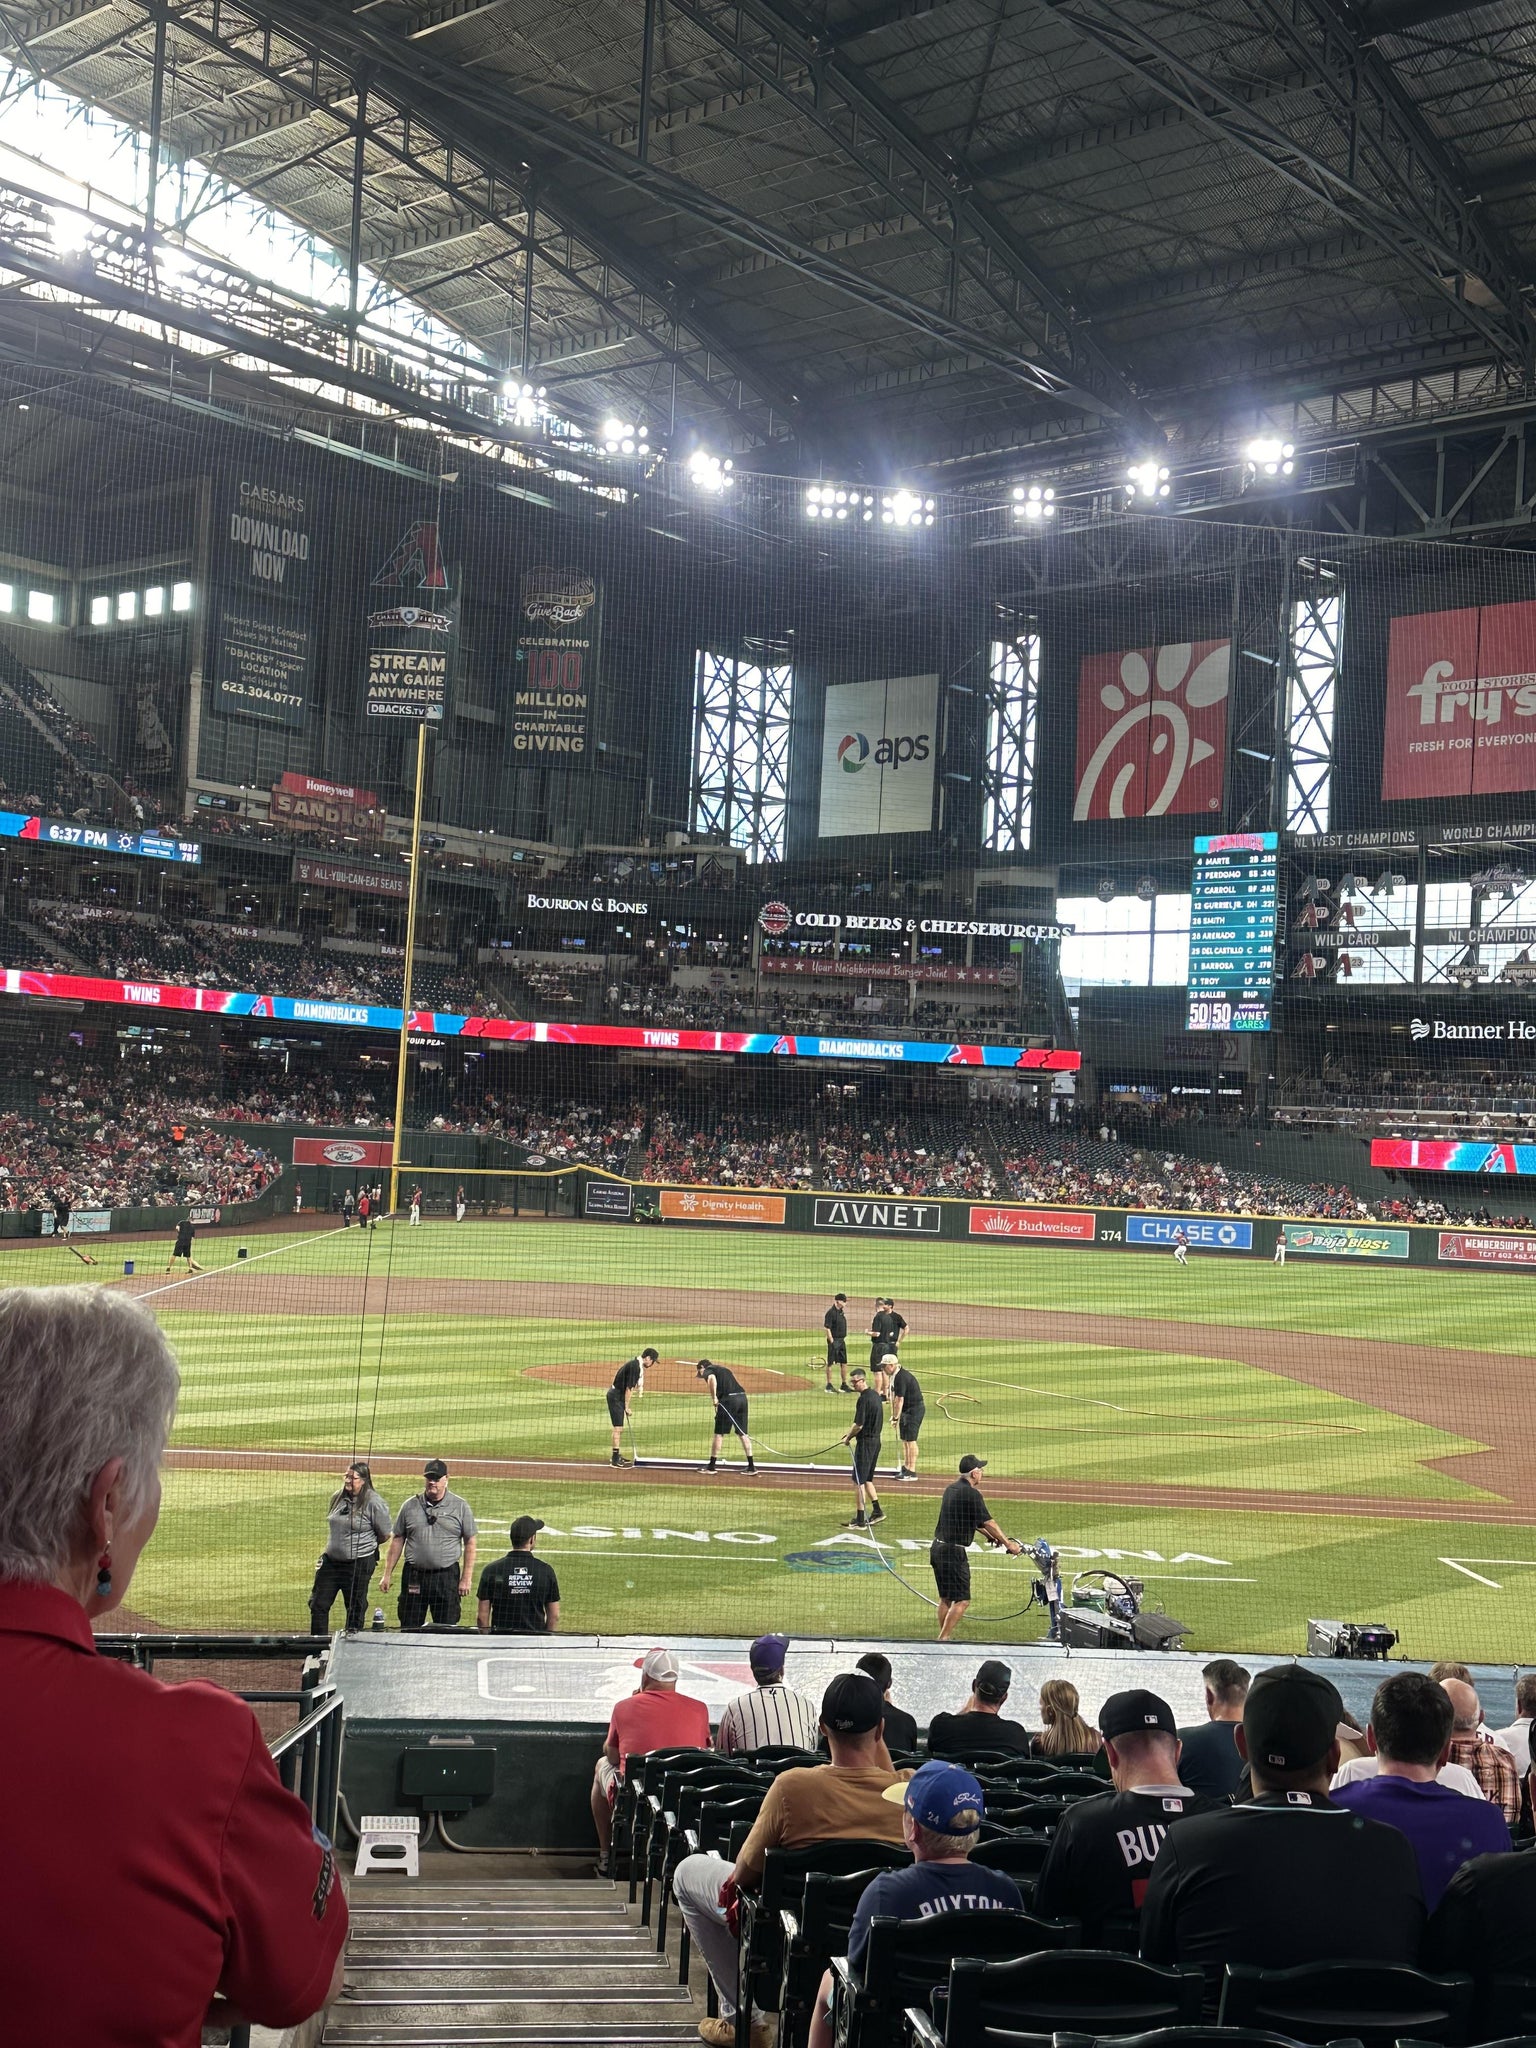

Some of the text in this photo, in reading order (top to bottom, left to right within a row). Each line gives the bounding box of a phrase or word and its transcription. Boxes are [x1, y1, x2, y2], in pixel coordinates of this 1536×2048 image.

[240, 481, 304, 512] CAESARS
[230, 513, 309, 560] DOWNLOAD
[252, 549, 286, 583] NOW
[527, 602, 584, 623] Give Back
[519, 637, 590, 648] CELEBRATING
[240, 661, 288, 680] LOCATION
[369, 654, 446, 672] STREAM
[368, 672, 445, 687] ANY GAME
[221, 680, 303, 707] 623.304.0777
[368, 687, 444, 701] ANYWHERE
[515, 691, 588, 708] MILLION
[543, 710, 557, 720] IN
[514, 722, 585, 734] CHARITABLE
[513, 734, 585, 752] GIVING
[1409, 740, 1445, 753] FRESH
[1448, 738, 1474, 750] FOR
[874, 734, 930, 770] aps
[306, 780, 355, 799] Honeywell
[50, 825, 108, 848] 6:37 PM
[1294, 830, 1415, 848] NL WEST CHAMPIONS
[1442, 826, 1483, 840] WORLD
[1205, 856, 1230, 865] MARTE
[314, 868, 379, 888] ALL-YOU-CAN-EAT
[380, 880, 403, 891] SEATS
[1205, 870, 1241, 879] PERDOMO
[1204, 886, 1236, 894] CARROLL
[591, 898, 604, 912] &
[795, 913, 1073, 940] COLD BEERS & CHEESEBURGERS
[1203, 916, 1225, 924] SMITH
[1202, 931, 1236, 940] ARENADO
[1315, 932, 1379, 947] WILD CARD
[1448, 929, 1464, 943] NL
[1214, 945, 1243, 954] CASTILLO
[811, 961, 948, 979] Your Neighborhood Burger Joint
[1201, 962, 1234, 970] BARBOSA
[1201, 977, 1220, 985] TROY
[123, 985, 368, 1023] TWINS DIAMONDBACKS
[1235, 1020, 1264, 1029] CARES
[1433, 1020, 1504, 1039] Banner
[643, 1031, 904, 1058] TWINS DIAMONDBACKS
[335, 1151, 354, 1161] Ford
[702, 1199, 763, 1211] Dignity Health
[829, 1203, 927, 1227] AVNET
[1018, 1219, 1083, 1234] Budweiser
[1142, 1222, 1214, 1242] CHASE
[1100, 1230, 1122, 1242] 374
[1313, 1235, 1391, 1250] Baja Blast
[1465, 1239, 1524, 1251] MEMBERSHIPS
[928, 1811, 939, 1824] 24
